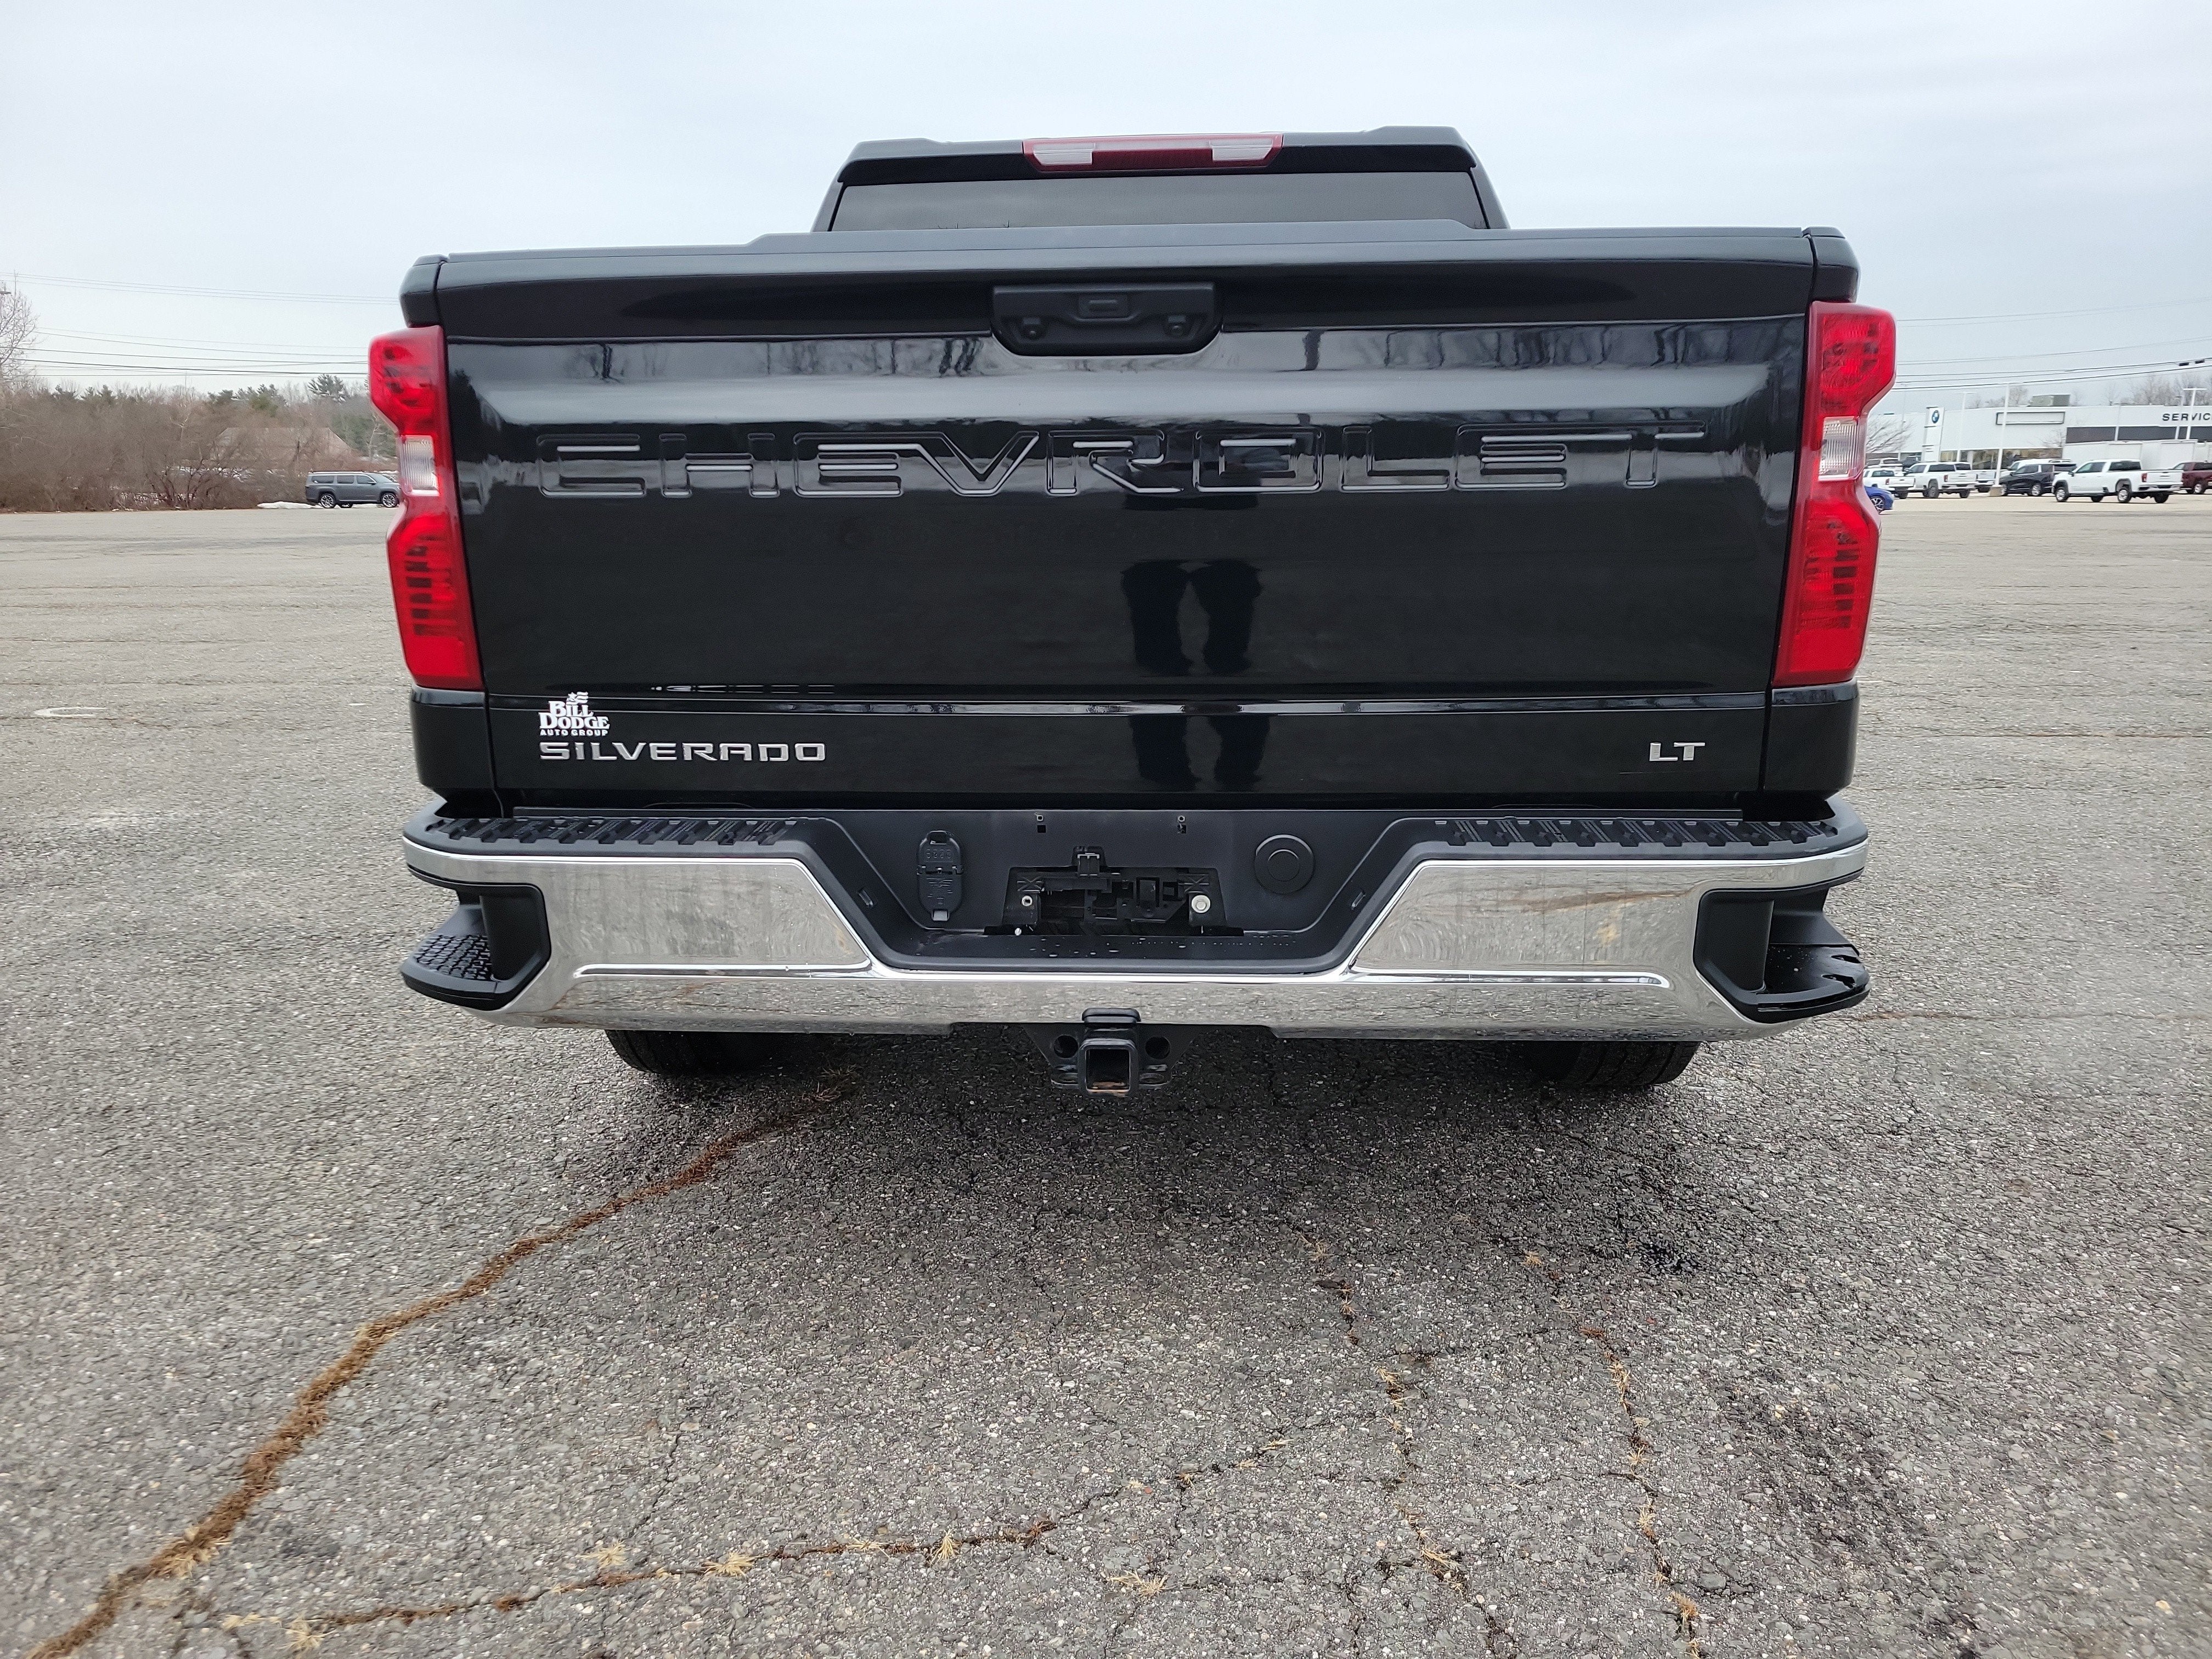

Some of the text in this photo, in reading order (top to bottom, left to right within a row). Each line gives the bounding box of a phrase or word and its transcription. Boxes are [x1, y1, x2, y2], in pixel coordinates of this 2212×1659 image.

[2162, 413, 2212, 421] SERVIC
[535, 420, 1708, 498] CHEVROLET
[548, 701, 594, 717] BILL
[538, 712, 610, 729] DODGE
[539, 742, 825, 761] SILVERADO
[1649, 742, 1706, 761] LT
